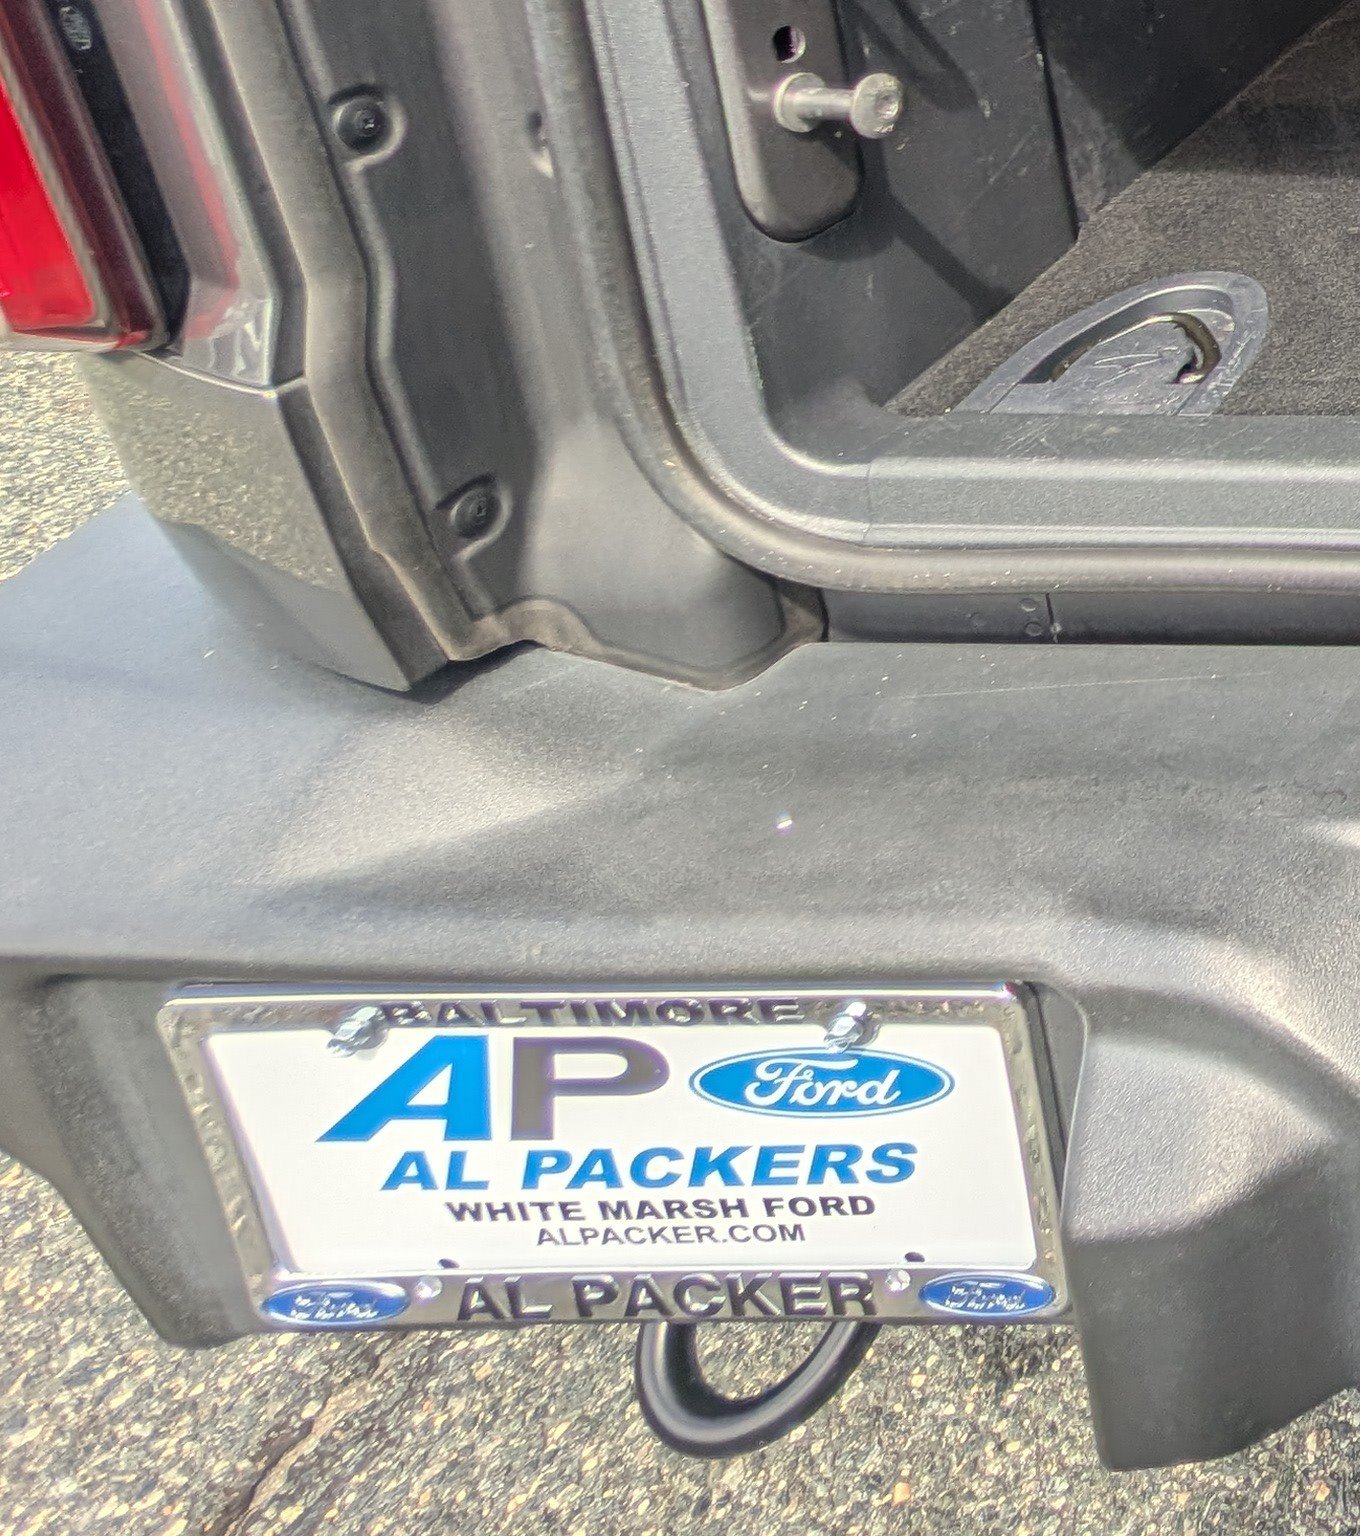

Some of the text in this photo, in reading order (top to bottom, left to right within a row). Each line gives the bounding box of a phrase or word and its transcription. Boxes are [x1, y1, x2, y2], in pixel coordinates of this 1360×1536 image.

[378, 999, 805, 1026] BALTIMORE
[315, 1035, 671, 1142] AP
[745, 1057, 902, 1107] Ford
[380, 1142, 919, 1191] AL PACKERS
[445, 1195, 877, 1222] WHITE MARSH FORD
[537, 1224, 806, 1247] ALPACKER.COM
[457, 1272, 879, 1321] AL PACKER
